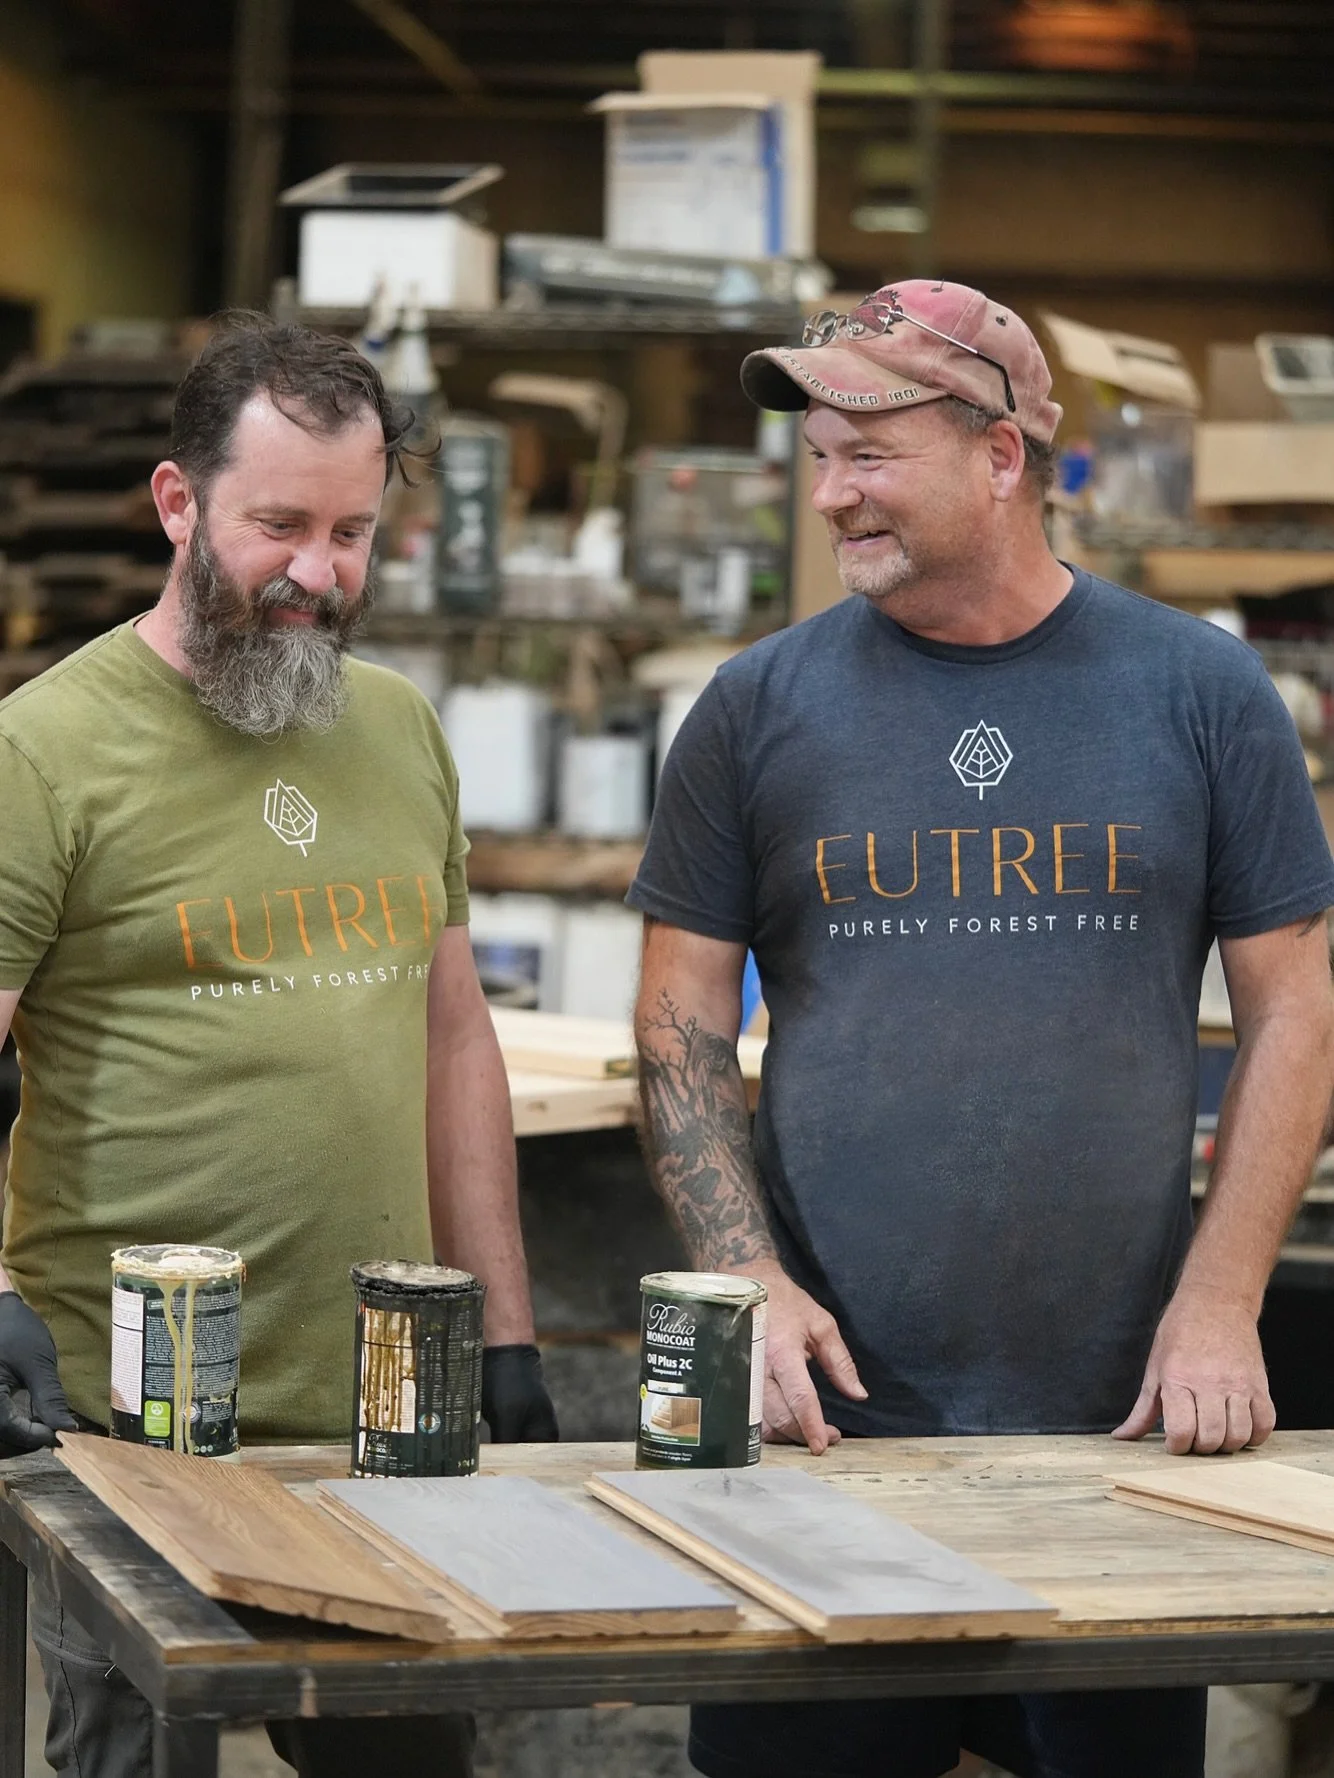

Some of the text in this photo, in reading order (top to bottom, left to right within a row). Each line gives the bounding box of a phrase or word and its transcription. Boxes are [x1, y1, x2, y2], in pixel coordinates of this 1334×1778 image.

[780, 353, 920, 406] ESTABLISHED 1801
[816, 823, 1142, 904] EUTREE
[829, 914, 1139, 939] PURELY FOREST FREE
[191, 963, 429, 1001] PURELY FOREST FRE
[646, 1303, 696, 1336] Rubio
[646, 1330, 696, 1347] MONOCOAT
[647, 1353, 693, 1370] Oil Plus 2C
